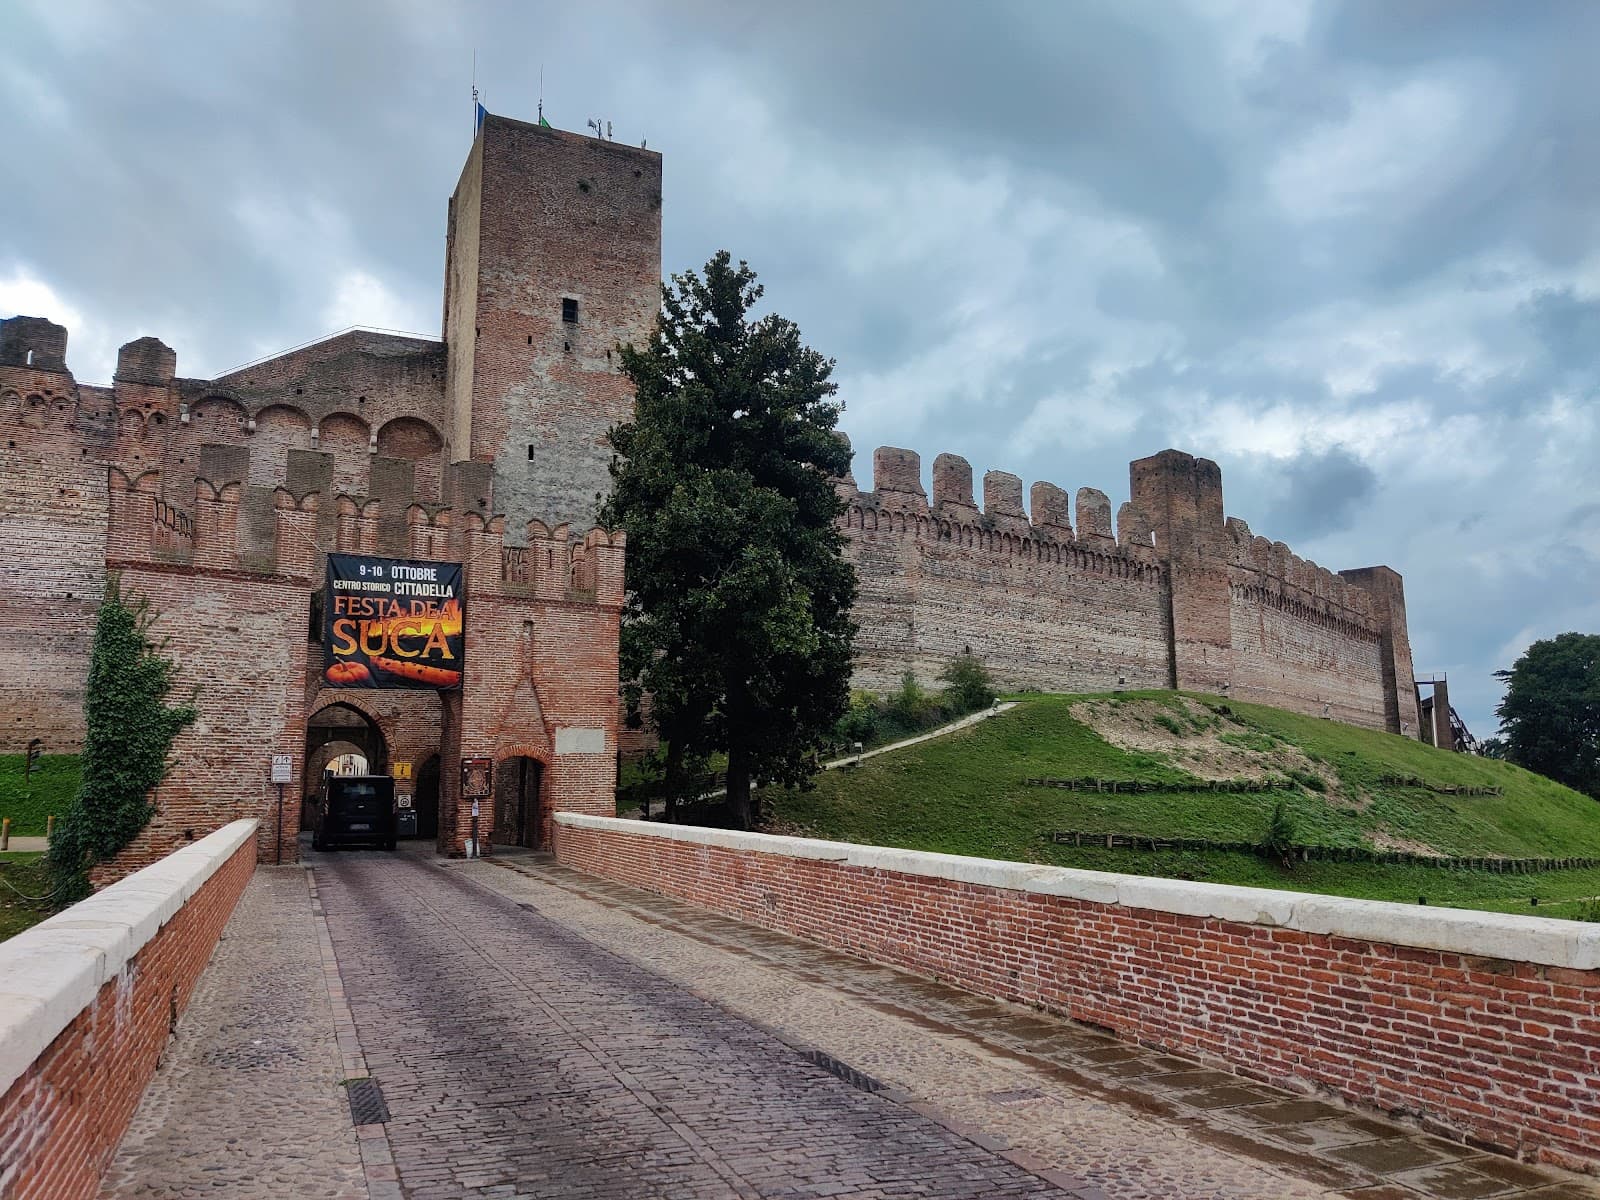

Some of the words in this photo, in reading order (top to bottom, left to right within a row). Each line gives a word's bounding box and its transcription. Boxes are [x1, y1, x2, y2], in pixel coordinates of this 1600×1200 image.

[391, 565, 438, 581] OTTOBRE
[333, 580, 361, 590] CENTRO
[361, 582, 391, 593] STORICO
[394, 581, 453, 598] CITTADELLA
[333, 595, 402, 618] FESTA
[410, 600, 455, 621] DEA
[332, 618, 455, 660] SUCA
